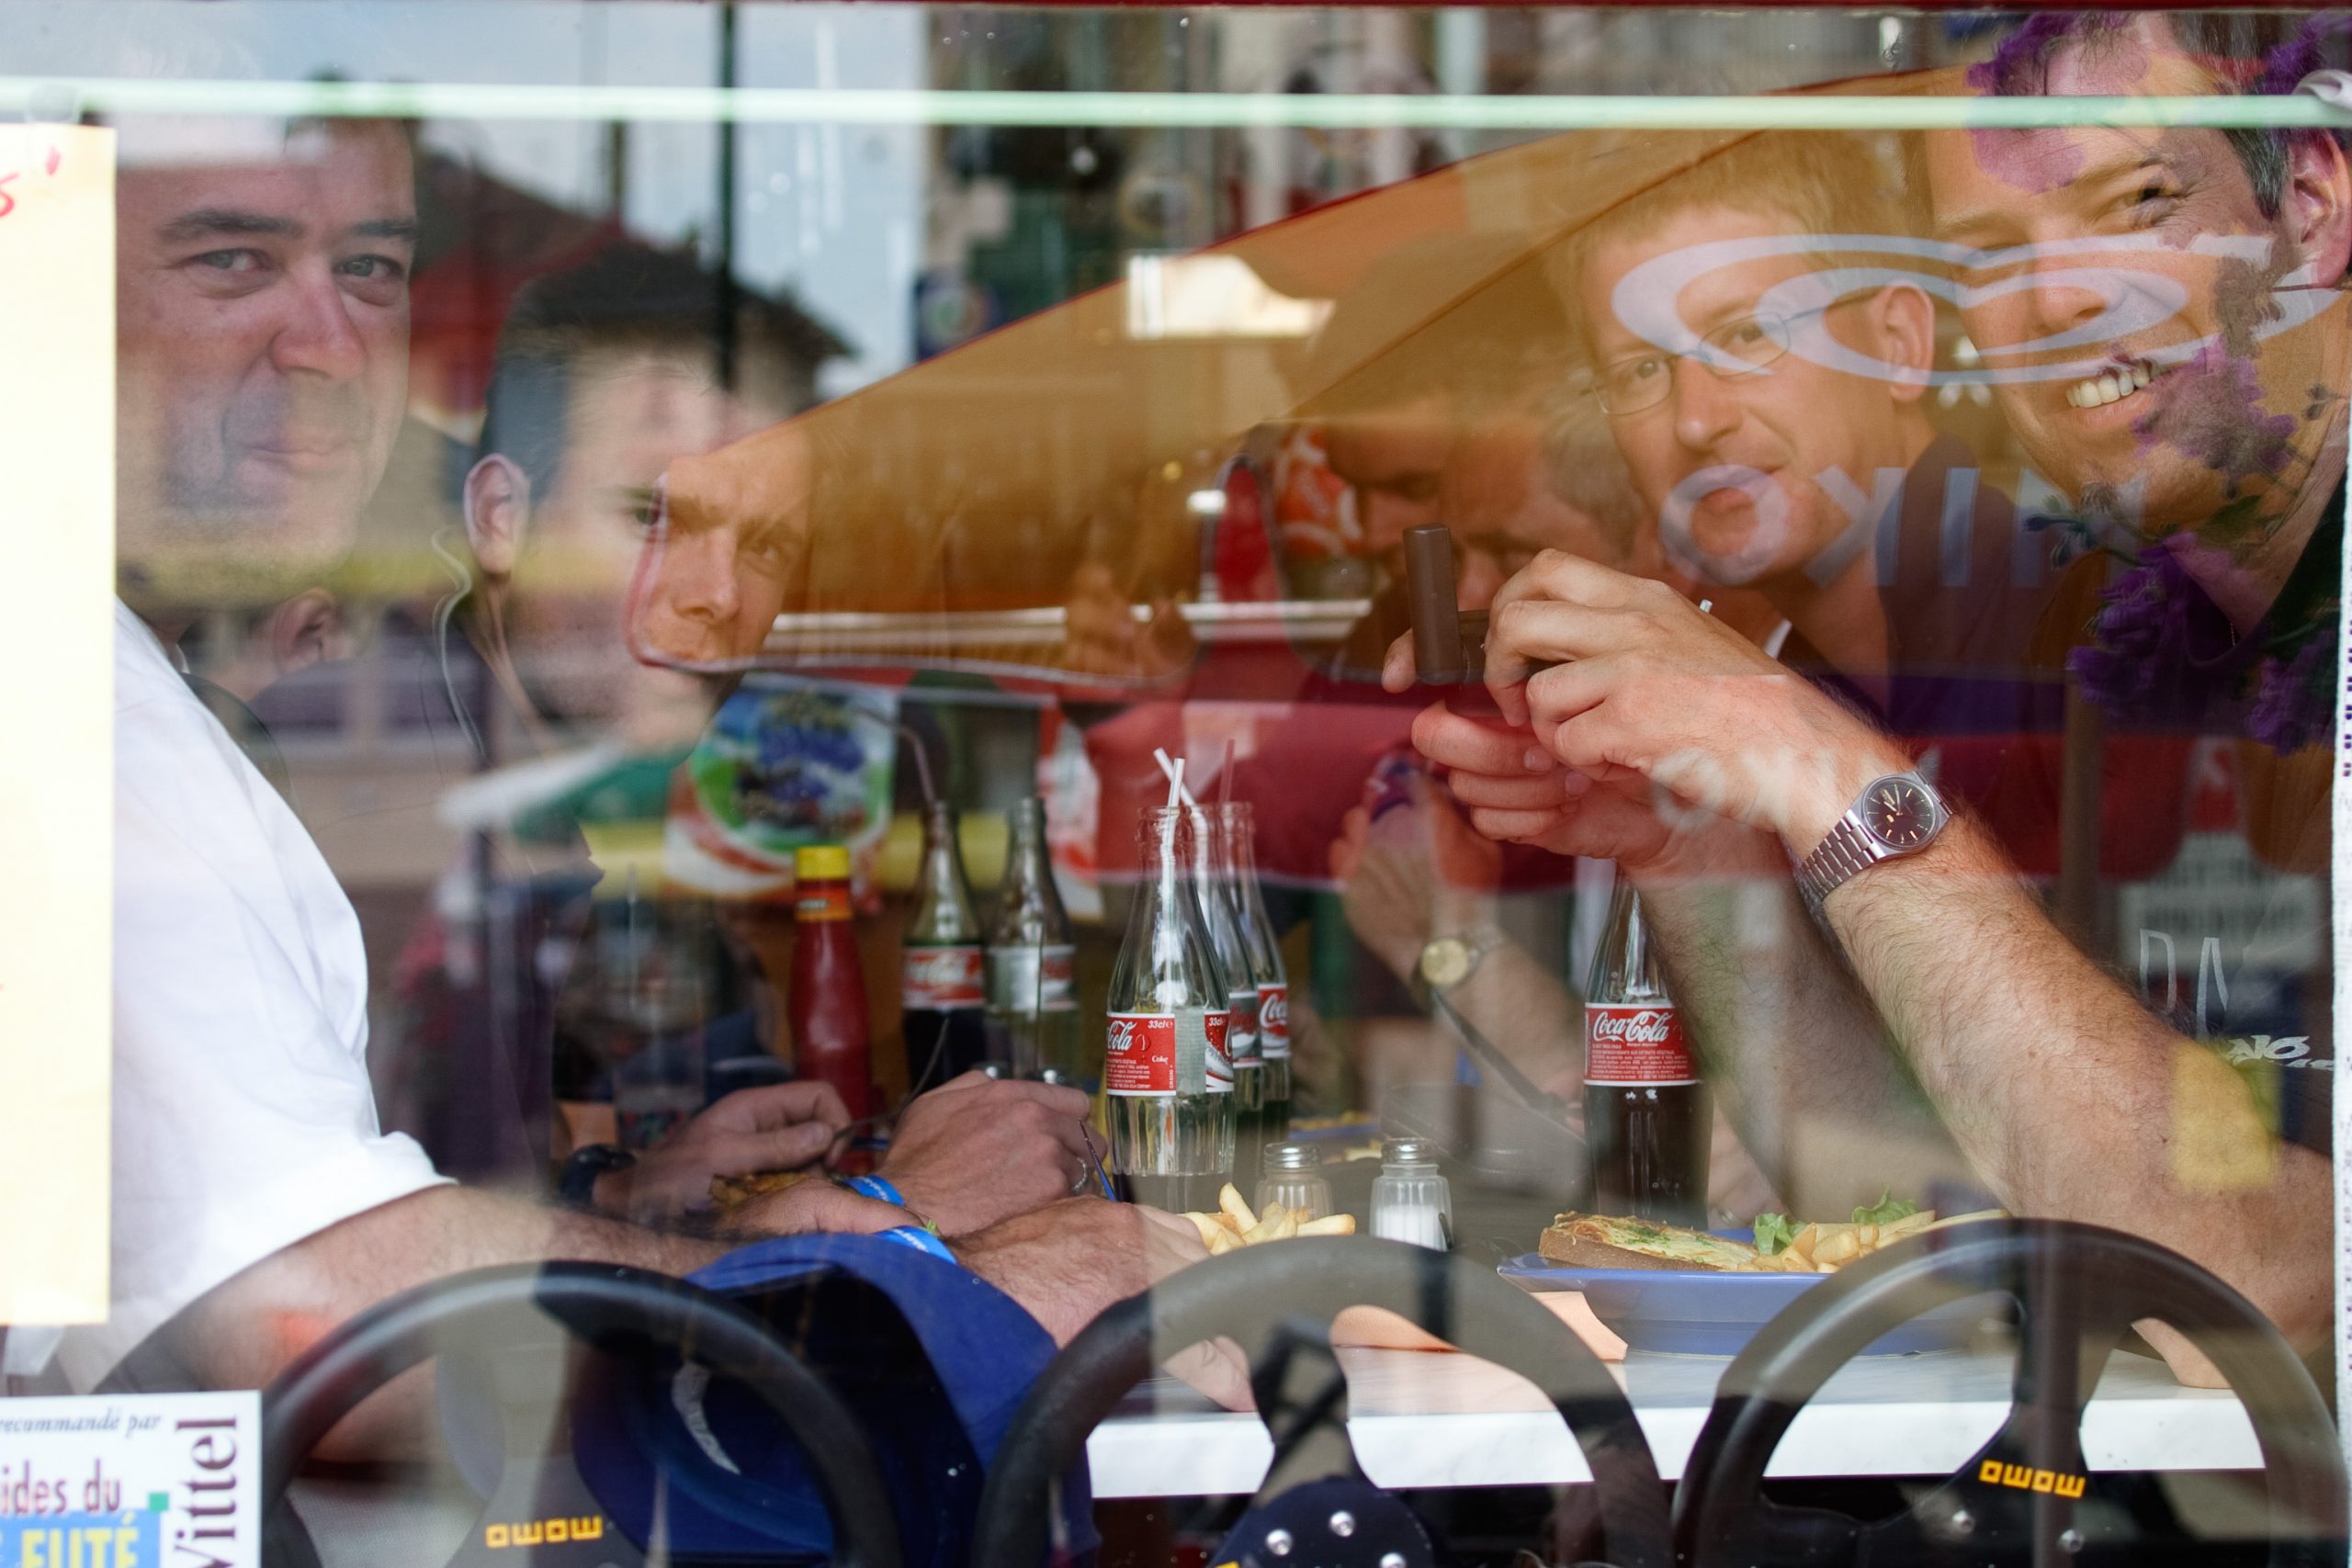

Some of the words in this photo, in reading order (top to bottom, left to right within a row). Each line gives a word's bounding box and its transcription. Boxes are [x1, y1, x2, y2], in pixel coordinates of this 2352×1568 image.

[1593, 1011, 1673, 1043] Coca-Cola
[125, 1414, 163, 1439] par
[84, 1458, 121, 1514] du
